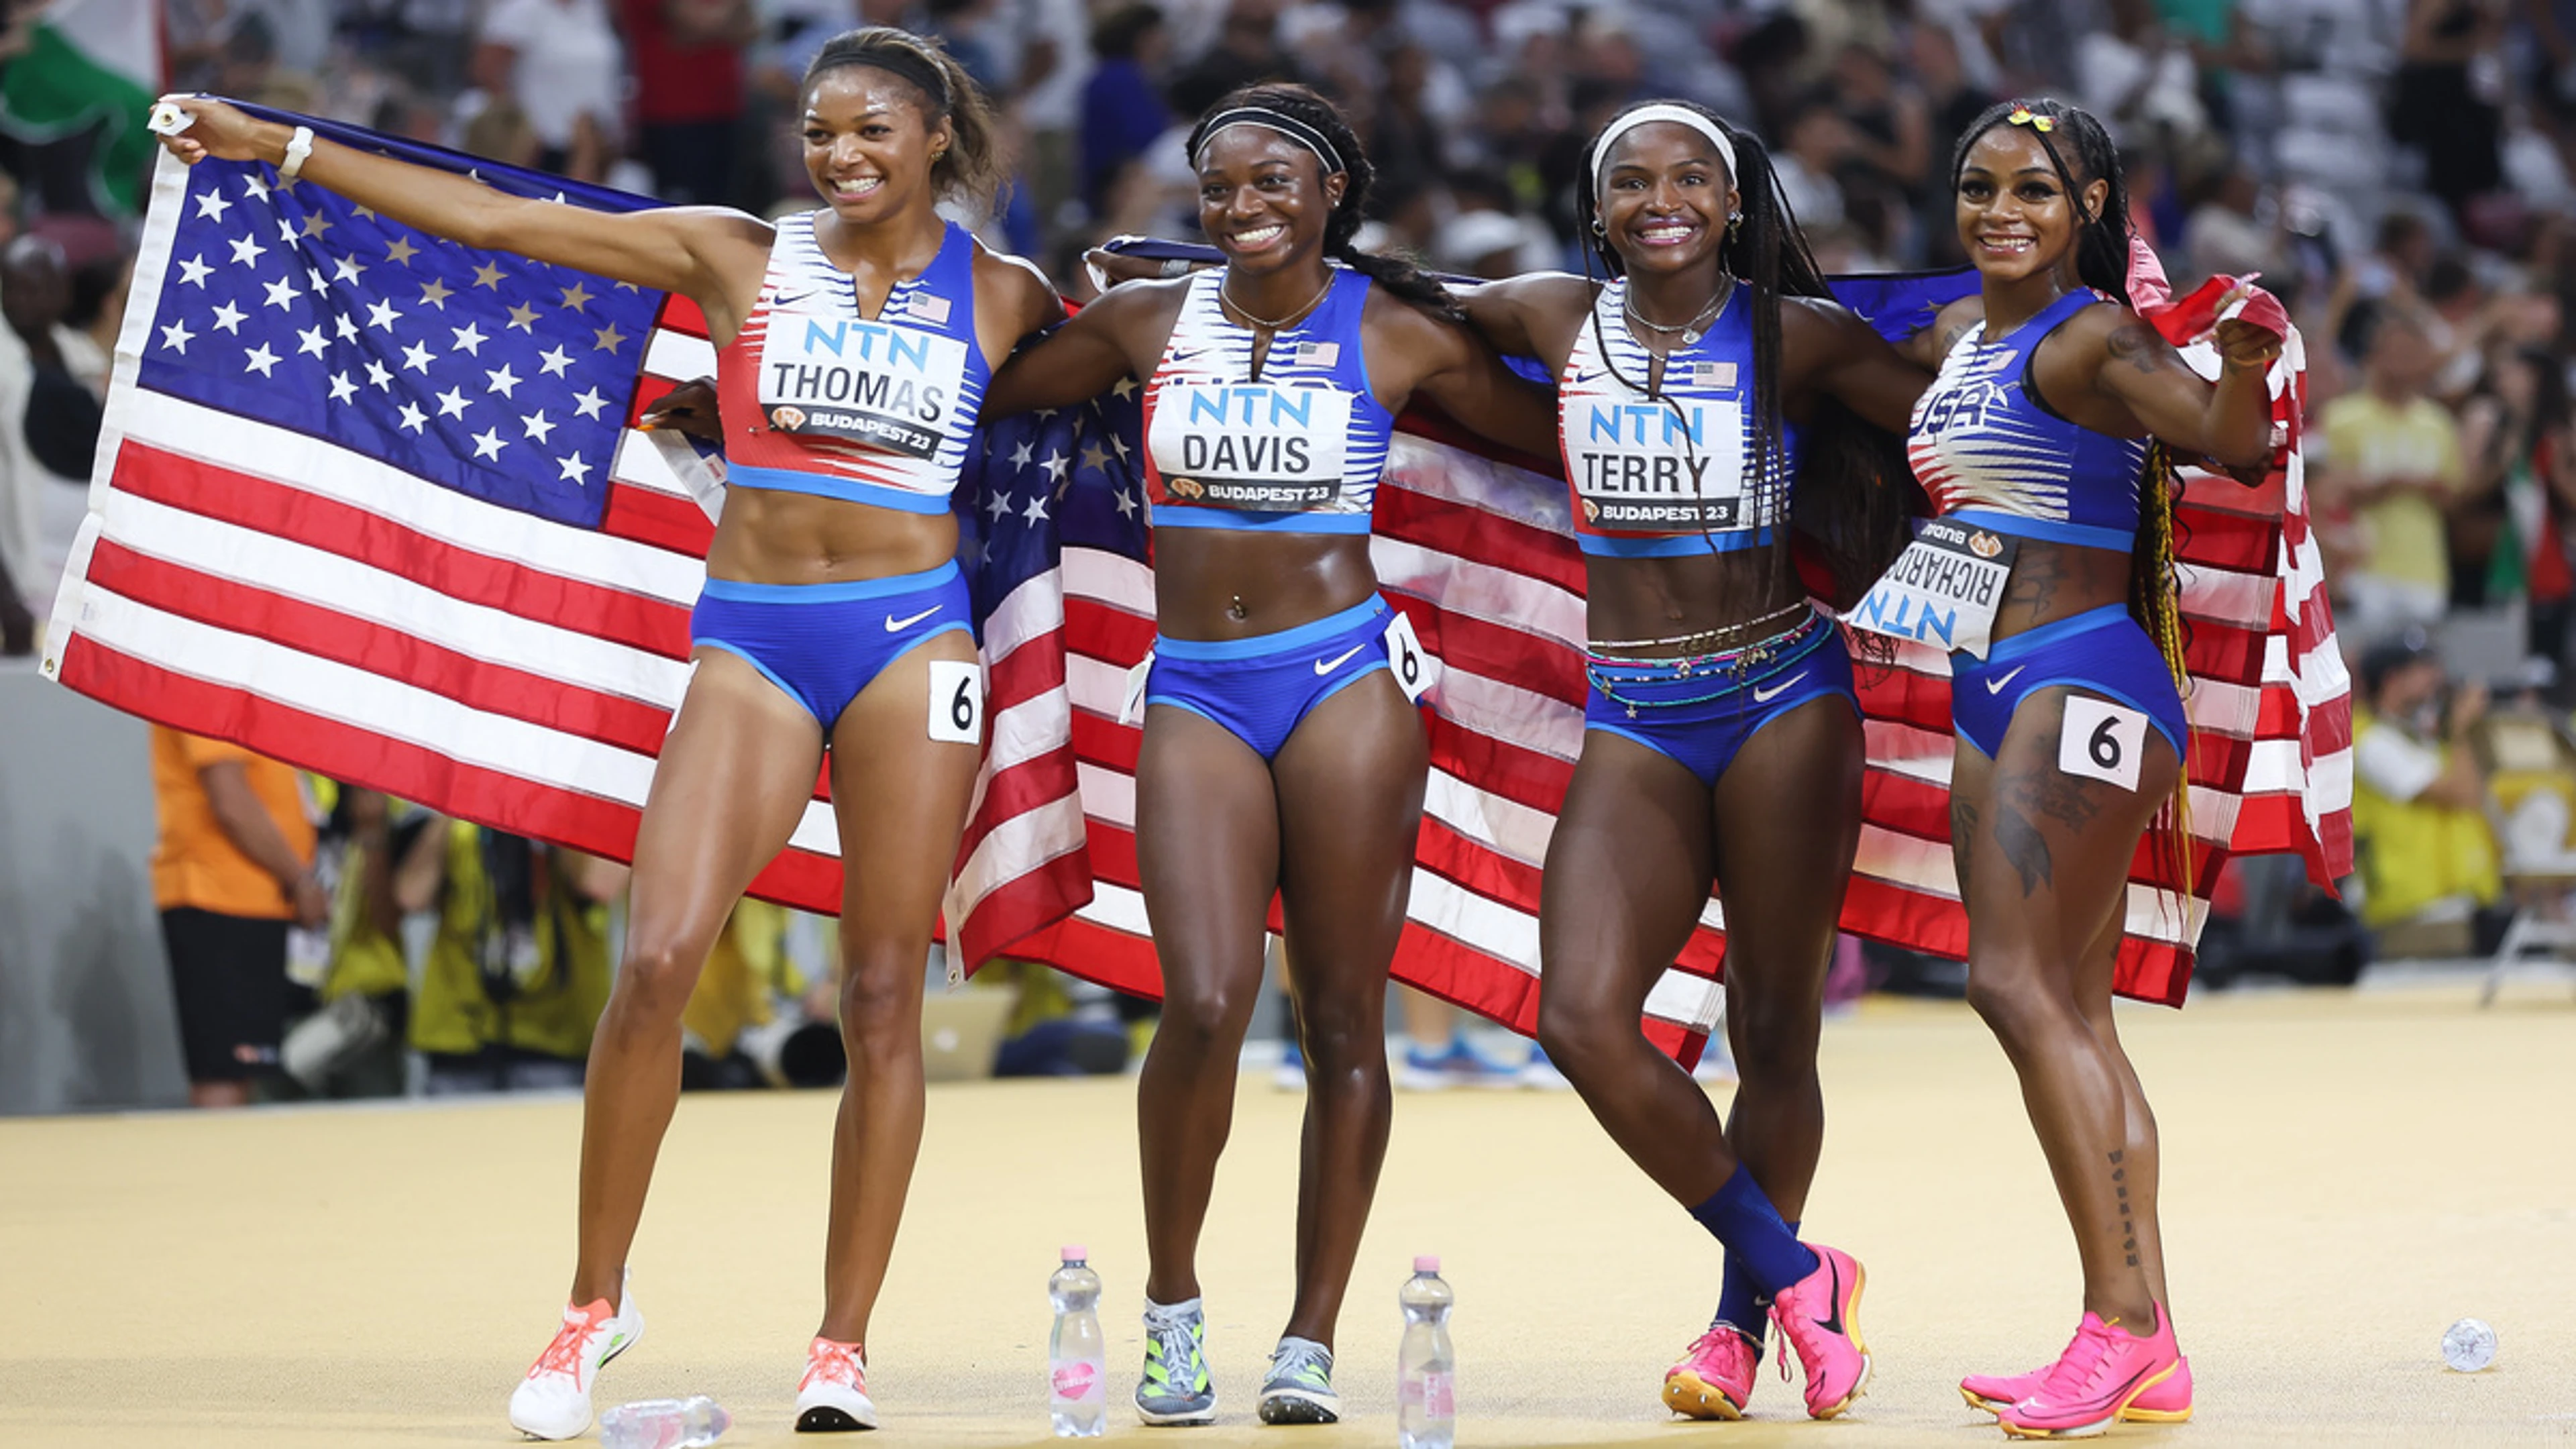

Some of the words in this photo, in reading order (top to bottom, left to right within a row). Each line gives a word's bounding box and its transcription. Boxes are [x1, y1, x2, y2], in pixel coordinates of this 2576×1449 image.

[805, 319, 930, 372] NTN
[773, 363, 943, 422] THOMAS
[1189, 388, 1311, 429] NTN
[810, 412, 911, 447] BUDAPEST
[910, 430, 930, 449] 23
[1590, 404, 1703, 447] NTN
[1183, 434, 1311, 474] DAVIS
[1582, 452, 1711, 493] TERRY
[1208, 484, 1306, 502] BUDAPEST
[1307, 486, 1330, 500] 23
[1602, 504, 1701, 521] BUDAPEST
[1706, 506, 1729, 520] 23
[1854, 589, 1957, 647] NTN
[1399, 633, 1418, 686] 6
[952, 676, 973, 731] 6
[2088, 715, 2122, 769] 6
